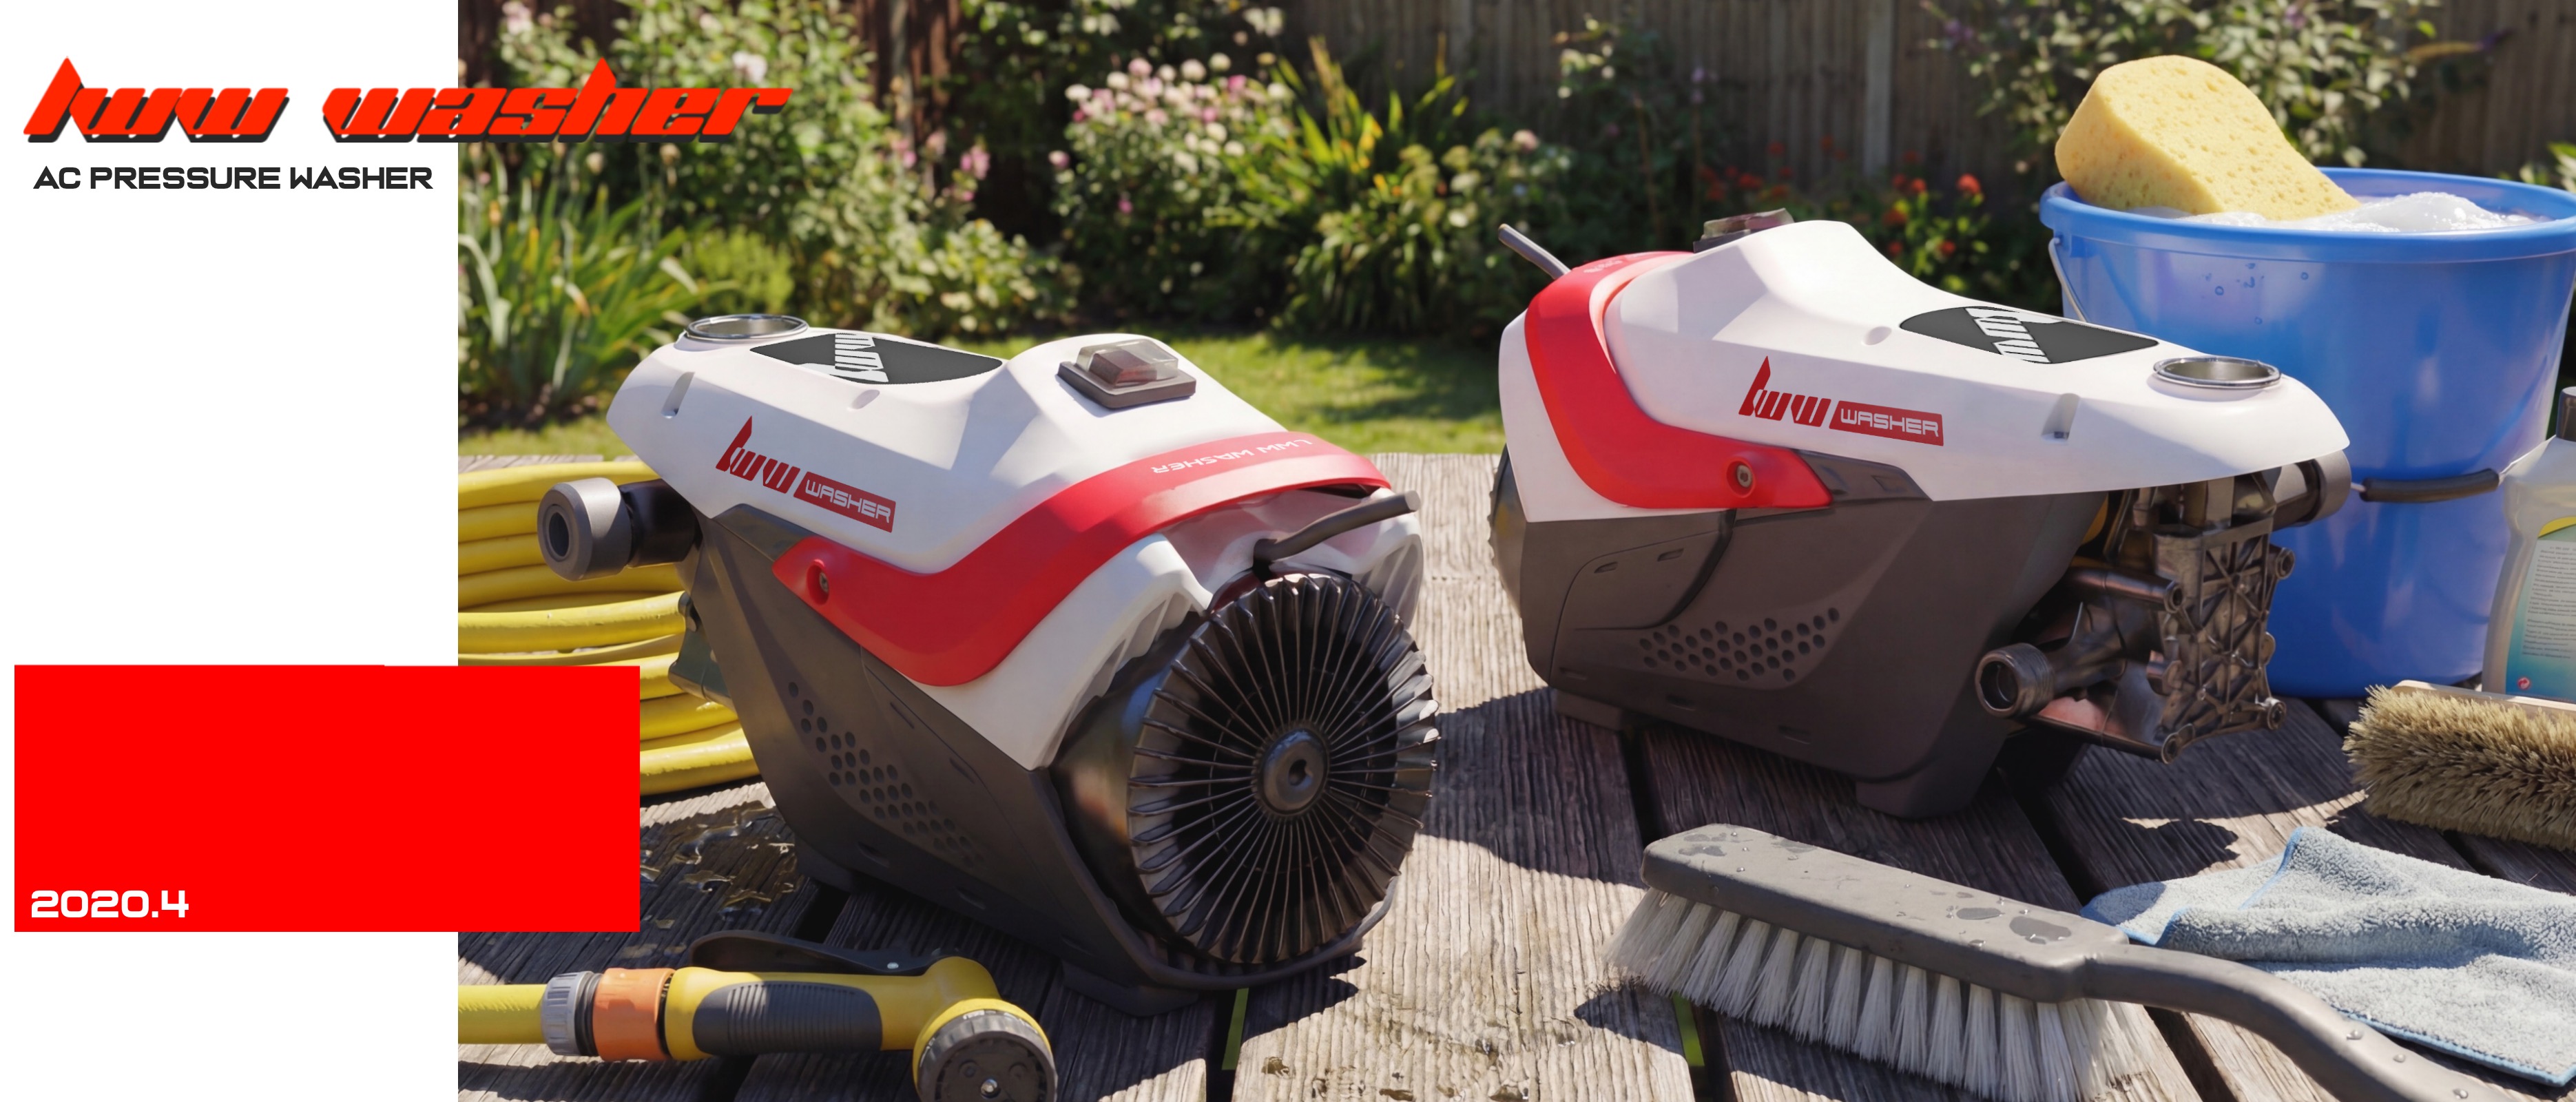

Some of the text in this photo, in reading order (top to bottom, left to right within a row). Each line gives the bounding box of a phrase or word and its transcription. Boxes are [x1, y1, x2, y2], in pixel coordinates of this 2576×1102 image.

[1840, 408, 1939, 437] WASHER
[1151, 449, 1255, 474] WASHER
[805, 479, 891, 523] WASHER
